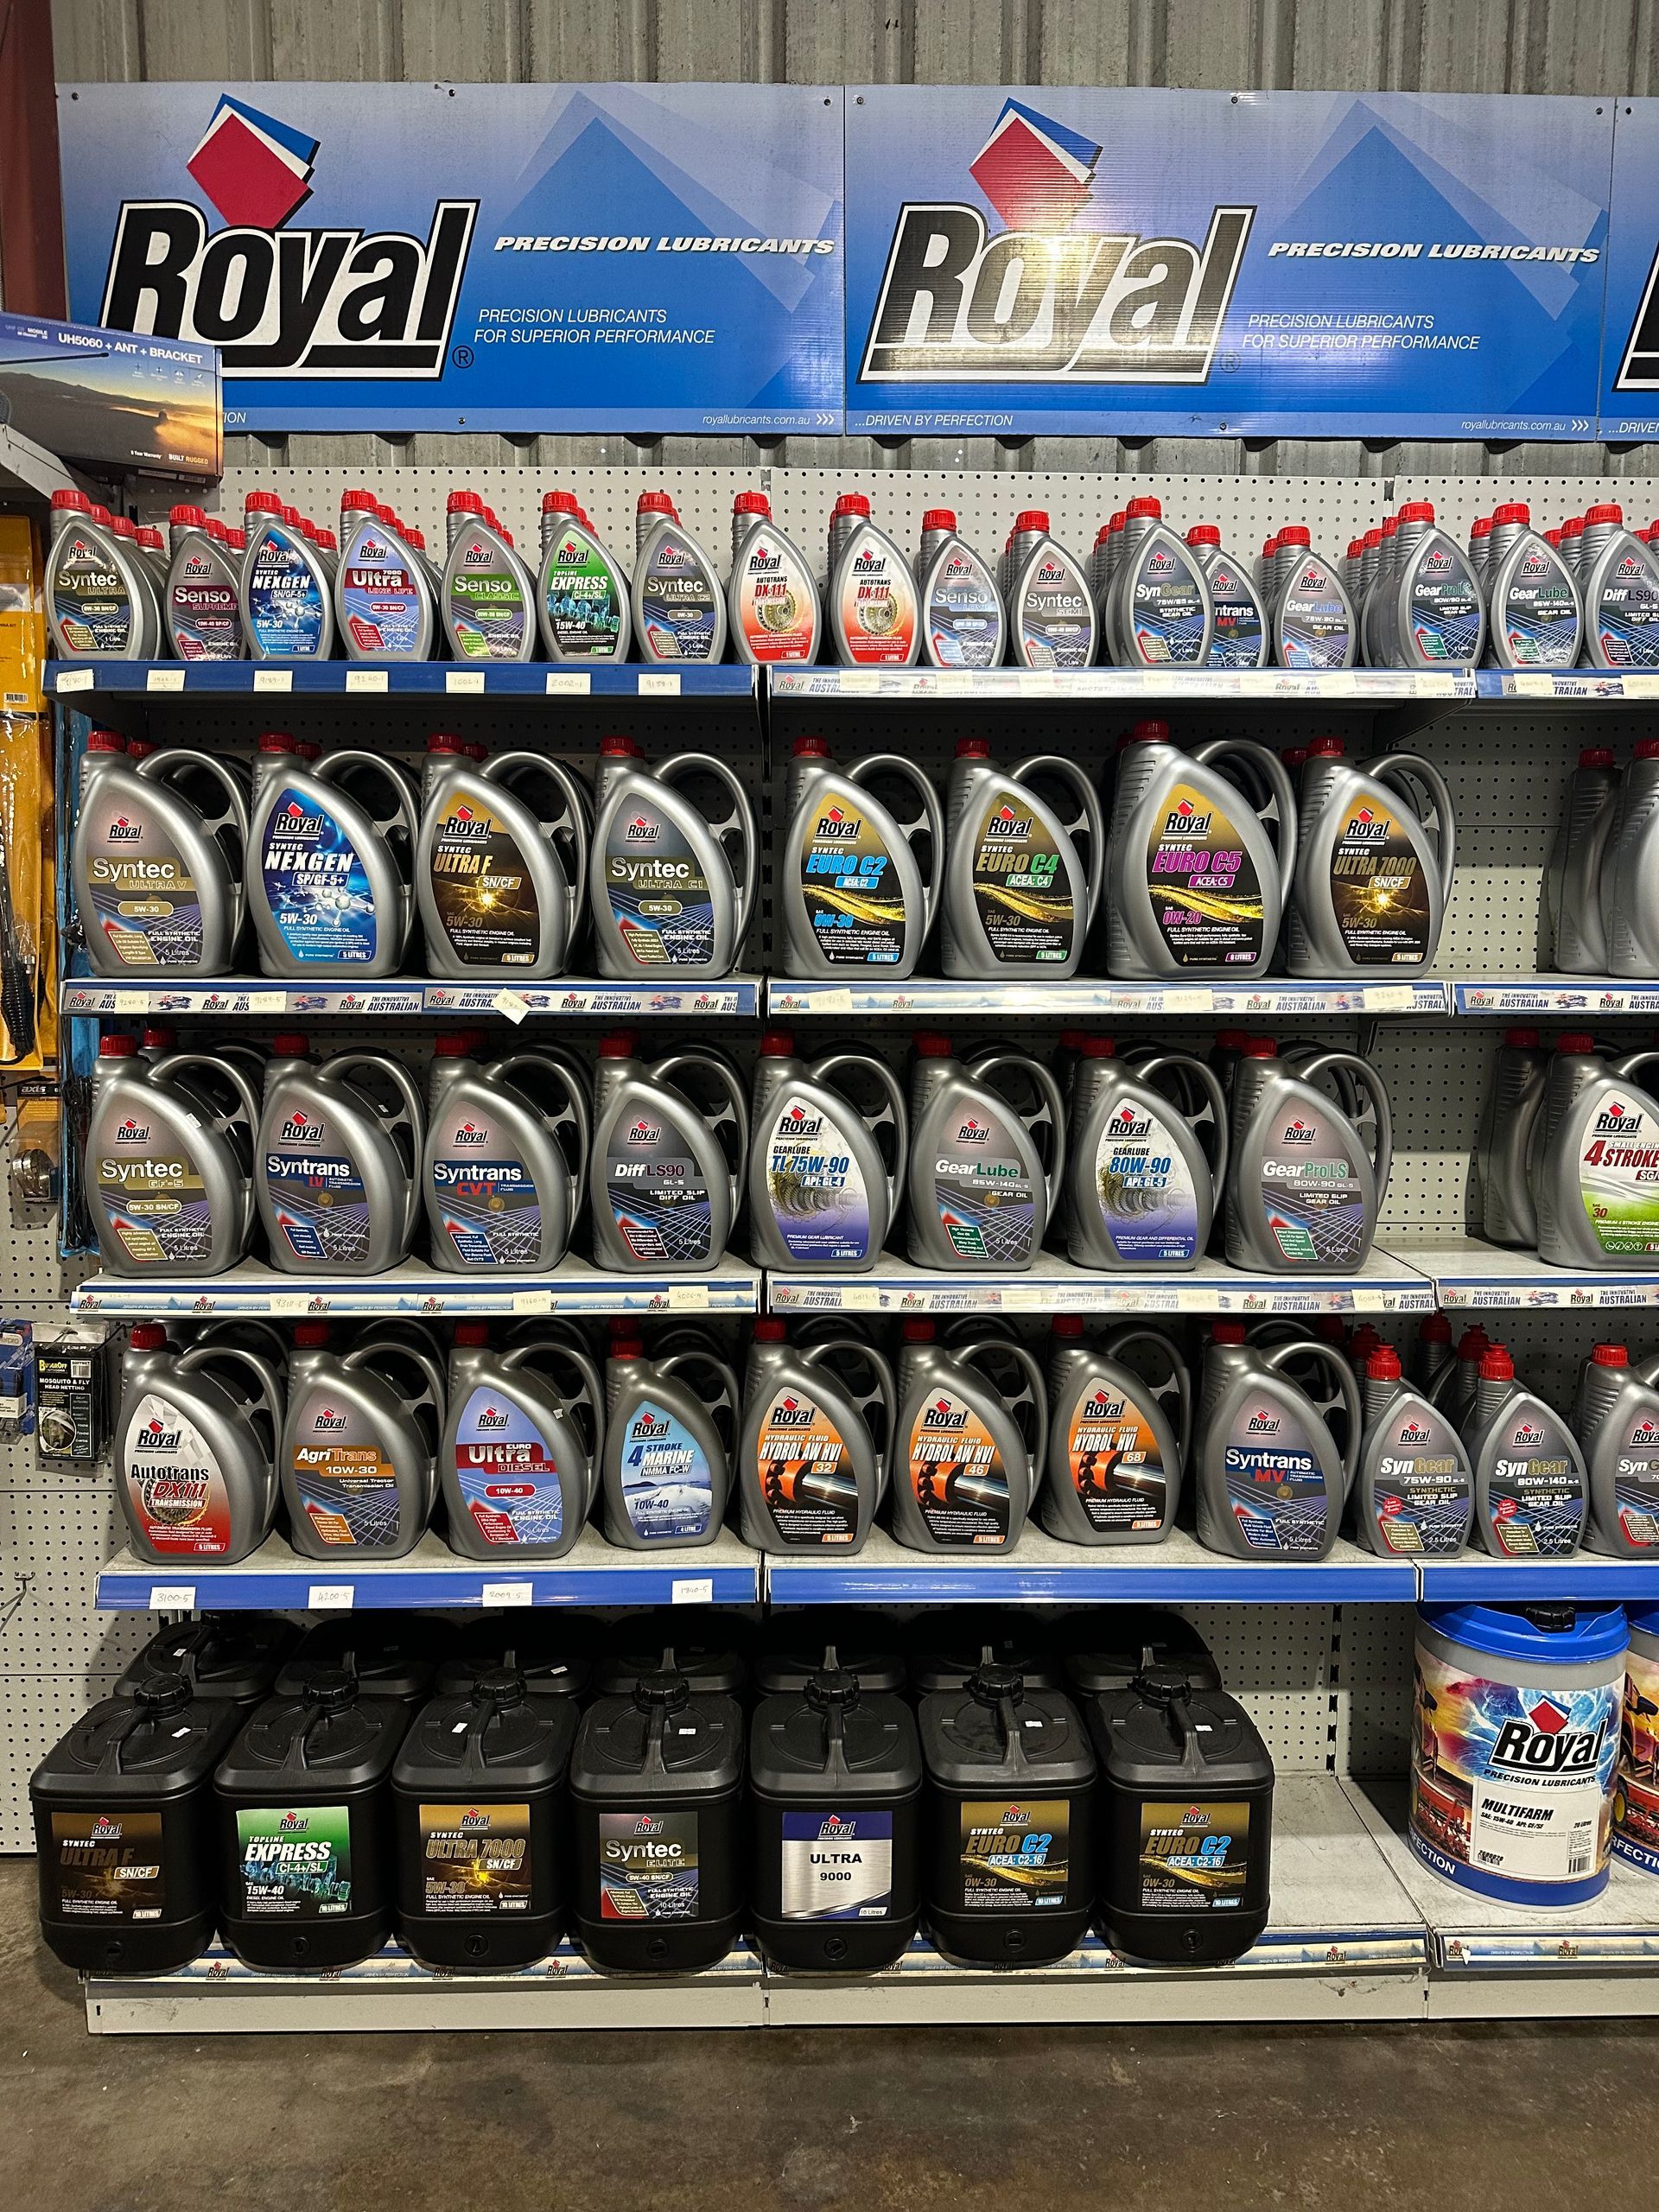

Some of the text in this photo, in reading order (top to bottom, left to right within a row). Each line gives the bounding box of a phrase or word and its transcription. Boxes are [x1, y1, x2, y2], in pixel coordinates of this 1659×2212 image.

[494, 237, 835, 254] PRECISION LUBRICANTS
[1268, 243, 1600, 263] PRECISION LUBRICANTS
[101, 200, 480, 379] Royal
[857, 202, 1257, 385] Royal
[479, 309, 667, 323] PRECISION LUBRICANTS
[1249, 315, 1434, 328] PRECISION LUBRICANTS
[474, 330, 715, 343] FOR SUPERIOR PERFORMANCE
[1242, 335, 1480, 350] FOR SUPERIOR PERFORMANCE
[59, 332, 202, 365] UH5060 + ANT + BRACKET
[702, 414, 810, 425] royallubricants.com.au
[915, 415, 933, 425] BY
[935, 416, 1013, 426] PERFECTION
[1461, 419, 1566, 431] royallubricants.com.au
[186, 456, 208, 465] RUGGED
[68, 547, 97, 561] Royal
[360, 545, 386, 558] Royal
[59, 571, 117, 588] Syntec
[251, 575, 310, 588] NEXGEN
[353, 573, 402, 586] Ultra
[454, 577, 512, 593] Senso
[551, 576, 607, 589] EXPRESS
[648, 577, 703, 595] Syntec
[175, 587, 230, 602] Senso
[935, 590, 988, 603] Senso
[1136, 584, 1193, 598] SynGear
[1510, 587, 1567, 601] GearLube
[1027, 594, 1081, 610] Syntec
[1287, 600, 1342, 613] GearLube
[276, 814, 322, 834] Royal
[816, 818, 861, 838] Royal
[264, 852, 353, 871] NEXGEN
[611, 858, 690, 880] Syntec
[805, 855, 887, 874] EURO C2
[976, 854, 1059, 873] EURO C4
[1152, 851, 1243, 873] EURO C5
[1333, 856, 1416, 875] ULTRA 7000
[92, 859, 175, 881] Syntec
[279, 913, 317, 925] 5W-30
[446, 915, 482, 927] 5W-30
[985, 915, 1020, 925] 5W-30
[1342, 918, 1376, 928] 5W-30
[590, 1001, 641, 1010] AUSTRALIAN
[1500, 999, 1549, 1008] AUSTRALIAN
[281, 1122, 324, 1141] Royal
[778, 1116, 823, 1136] Royal
[1595, 1114, 1642, 1133] Royal
[102, 1160, 182, 1185] Syntec
[268, 1156, 350, 1178] Syntrans
[772, 1156, 849, 1174] TL 75W-90
[936, 1160, 1019, 1179] GearLube
[1108, 1156, 1171, 1174] 80W-90
[309, 1177, 323, 1187] LV
[434, 1164, 522, 1184] Syntrans
[804, 1176, 844, 1186] API: GL-4
[456, 1183, 496, 1196] CVT
[930, 1300, 977, 1309] AUSTRALIAN
[1472, 1296, 1521, 1306] AUSTRALIAN
[632, 1422, 670, 1440] Royal
[138, 1431, 181, 1448] Royal
[1072, 1433, 1137, 1451] HYDROL HVI
[296, 1448, 377, 1464] AgriTrans
[468, 1446, 531, 1463] Ultra
[642, 1450, 694, 1465] MARINE
[912, 1445, 995, 1463] HYDROL AW HVI
[1226, 1450, 1312, 1471] Syntrans
[131, 1465, 208, 1480] Autotrans
[1381, 1458, 1455, 1475] SynGear
[1496, 1459, 1567, 1478] SynGear
[1255, 1471, 1285, 1483] MV
[634, 1499, 669, 1510] 10W-40
[1488, 1718, 1608, 1775] Royal
[1481, 1798, 1554, 1821] MULTIFARM
[819, 1821, 856, 1839] Royal
[245, 1842, 331, 1861] EXPRESS
[426, 1839, 525, 1858] ULTRA 7000
[606, 1840, 682, 1862] Syntec
[965, 1834, 1052, 1853] EURO C2
[1144, 1836, 1231, 1855] EURO C2
[810, 1853, 861, 1864] ULTRA
[246, 1885, 284, 1895] 15W-40
[426, 1881, 466, 1894] 5W-30
[965, 1878, 997, 1887] 0W-30
[1142, 1878, 1175, 1888] 0W-30
